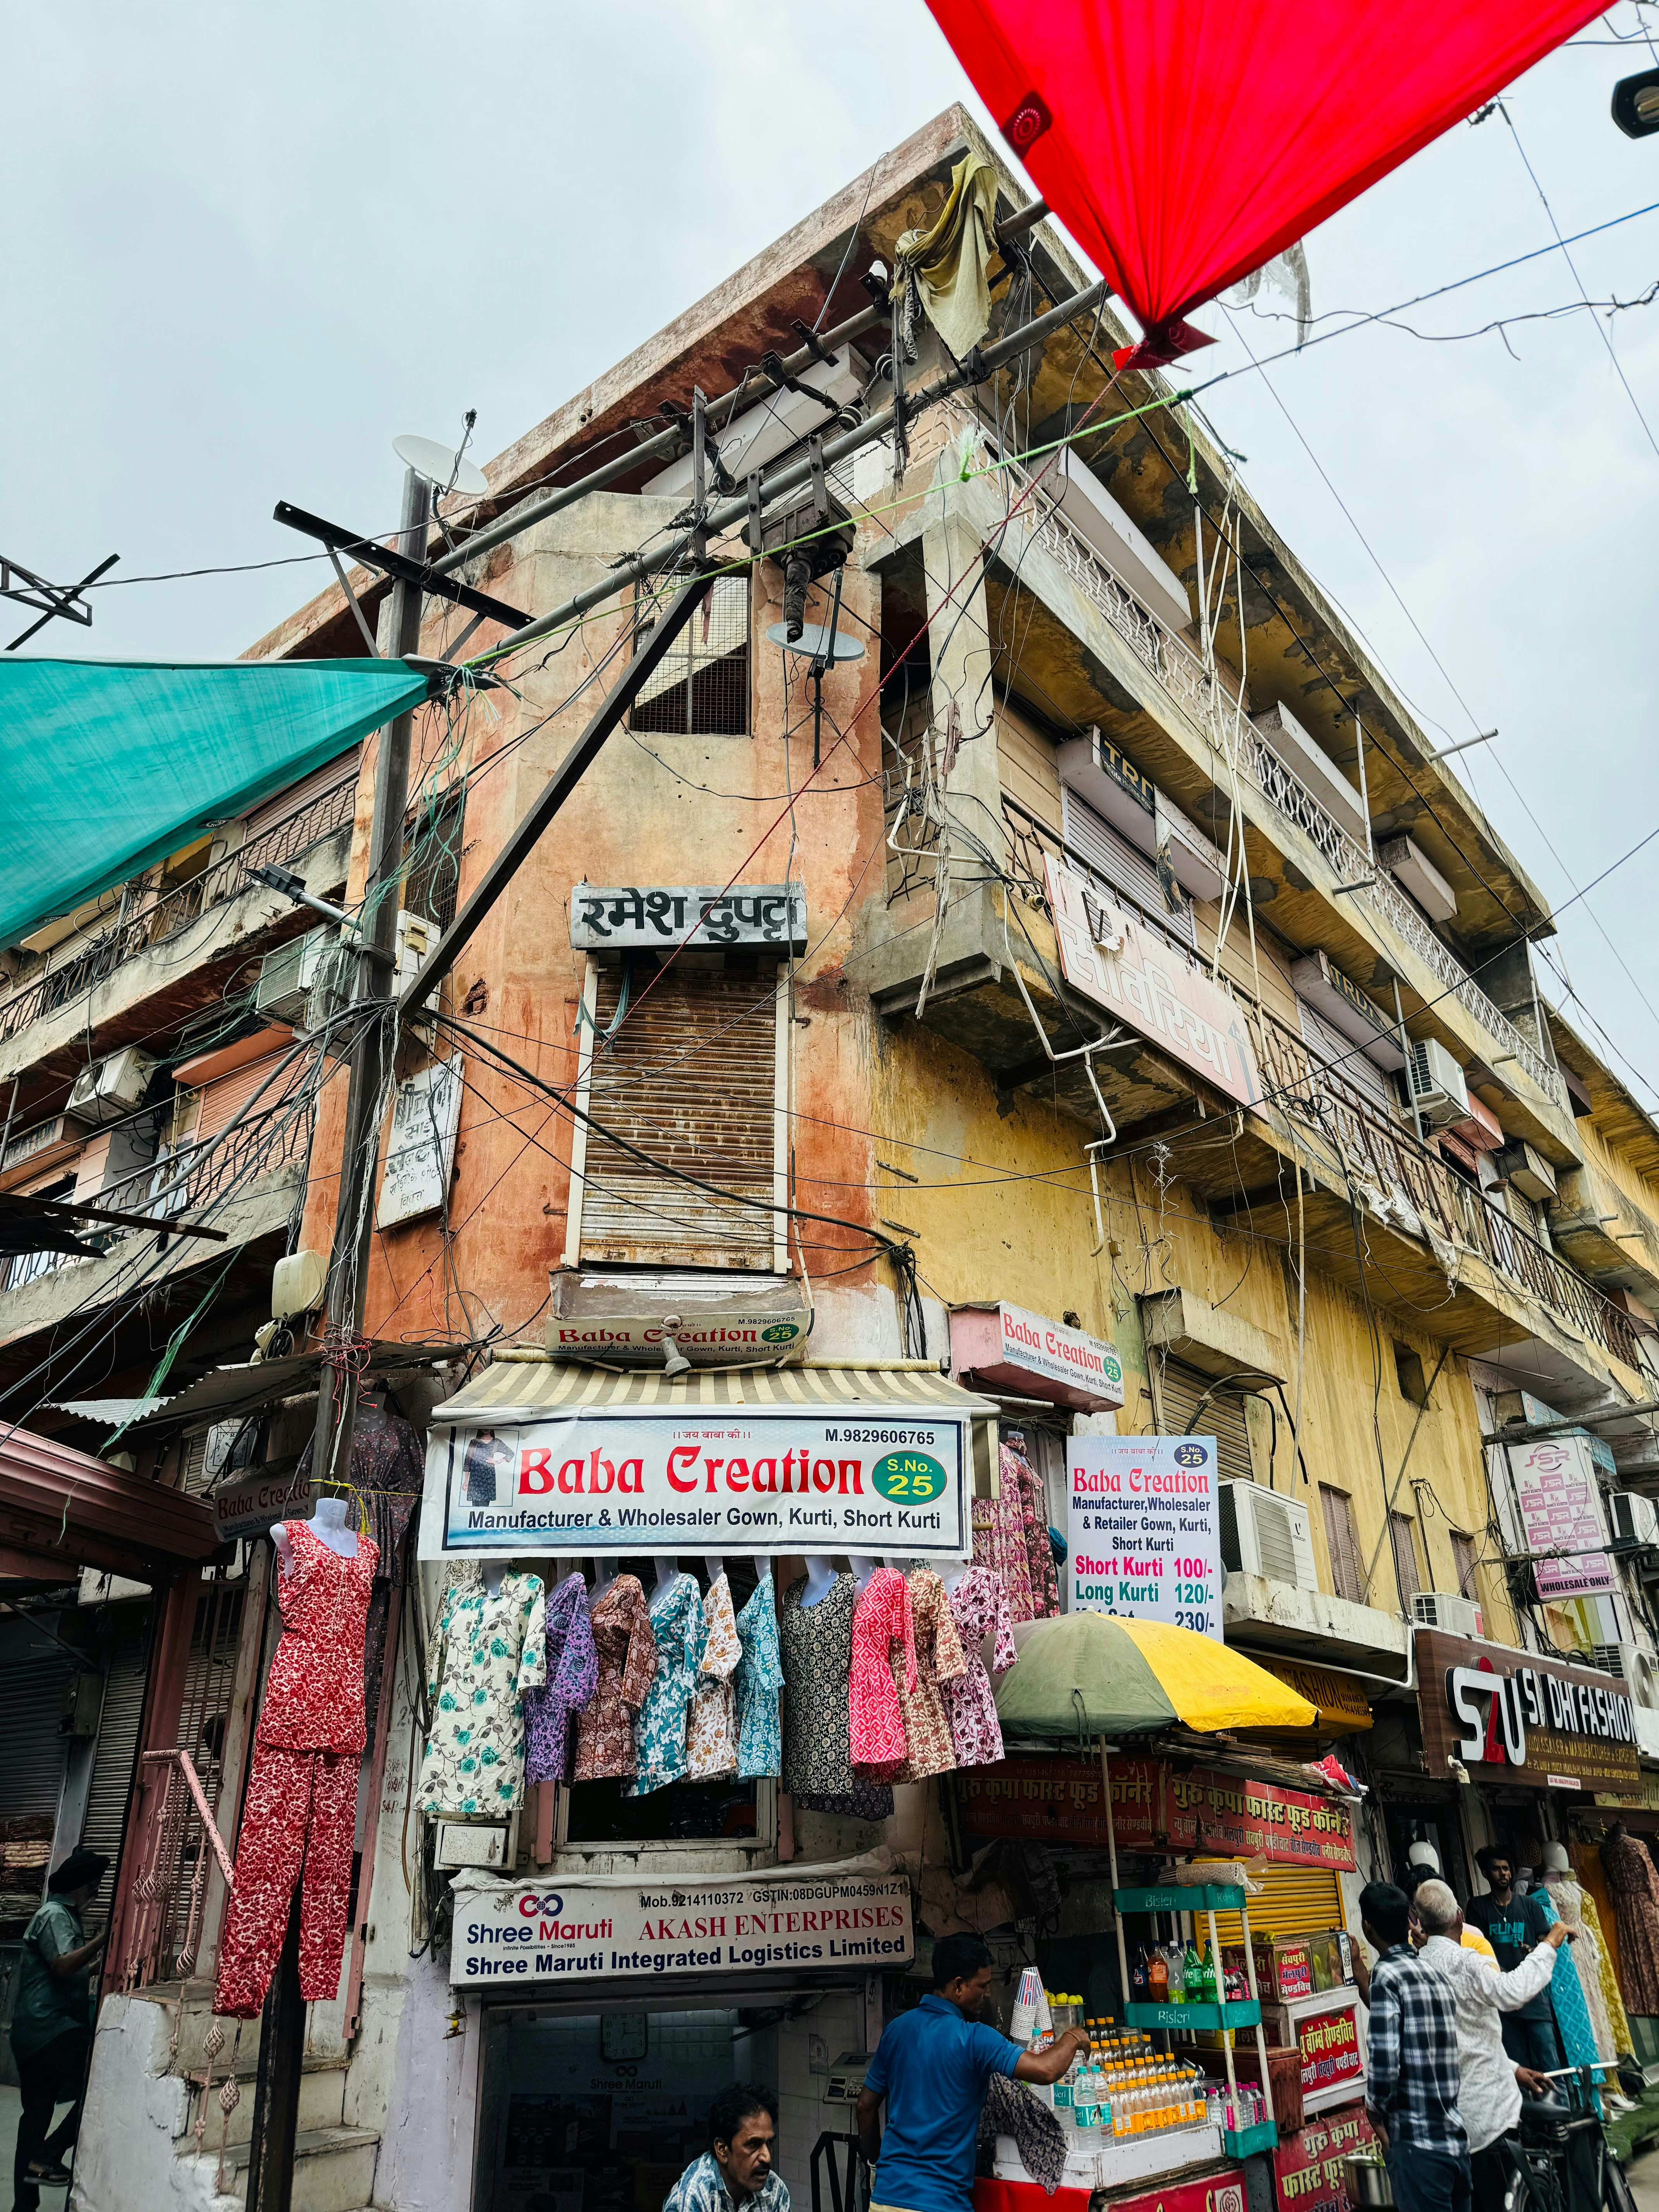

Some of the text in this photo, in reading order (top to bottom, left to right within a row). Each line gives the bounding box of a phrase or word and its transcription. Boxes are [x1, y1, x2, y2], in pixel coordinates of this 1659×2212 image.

[579, 888, 687, 936] रमेश
[738, 1316, 795, 1325] M.9829606765
[559, 1329, 631, 1343] Baba
[769, 1331, 791, 1340] 25
[1003, 1313, 1103, 1373] Baba Creation
[718, 1344, 742, 1352] Kurti,
[773, 1343, 794, 1351] Kurti
[1005, 1343, 1122, 1395] Manufacturer & Wholesaler Gown, Kurti, Short Kurti
[1106, 1359, 1117, 1368] S.No.
[1107, 1367, 1119, 1379] 25
[702, 1431, 724, 1439] बाबा
[825, 1429, 935, 1445] M.9829606765
[887, 1459, 933, 1472] S.No.
[1181, 1453, 1203, 1465] 25
[1524, 1450, 1571, 1468] JSR
[518, 1446, 864, 1494] Baba Creation
[1073, 1468, 1209, 1493] Baba Creation
[887, 1475, 933, 1496] 25
[218, 1479, 310, 1520] Baba Creatio
[223, 1519, 255, 1532] Manufacturer
[468, 1508, 940, 1529] Manufacturer & Wholesaler Gown, Kurti, Short Kurti
[1083, 1516, 1211, 1535] & Retailer Gown, Kurti,
[1113, 1536, 1174, 1551] Short Kurti
[1075, 1555, 1213, 1578] Short Kurti 100/-
[1076, 1580, 1214, 1606] Long Kurti 120/-
[1540, 1576, 1609, 1592] WHOLESALE ONLY
[1175, 1611, 1214, 1632] 230/-
[1283, 1667, 1345, 1710] FASHION
[1578, 1685, 1638, 1744] FASHION
[1526, 1734, 1565, 1755] WHOLESALER
[1569, 1741, 1611, 1761] MANUFACTURER
[985, 1778, 1020, 1805] कृपा
[1068, 1781, 1100, 1809] फूड
[1172, 1778, 1204, 1808] गुरु
[1207, 1786, 1244, 1815] कृपा
[1286, 1804, 1310, 1833] फूड
[641, 1883, 903, 1908] Mob.9214110372 GSTIN:08DGUPM0459N1Z1
[467, 1919, 612, 1944] Shree Maruti
[638, 1906, 903, 1940] AKASH ENTERPRISES
[465, 1935, 905, 1975] Shree Maruti Integrated Logistics Limited
[1281, 1951, 1305, 1965] सेवपुरी
[1282, 1965, 1307, 1980] भेलपुरी
[591, 2078, 662, 2090] Shree Maruti
[1304, 2131, 1329, 2160] गुरु
[1331, 2119, 1359, 2148] कृपा
